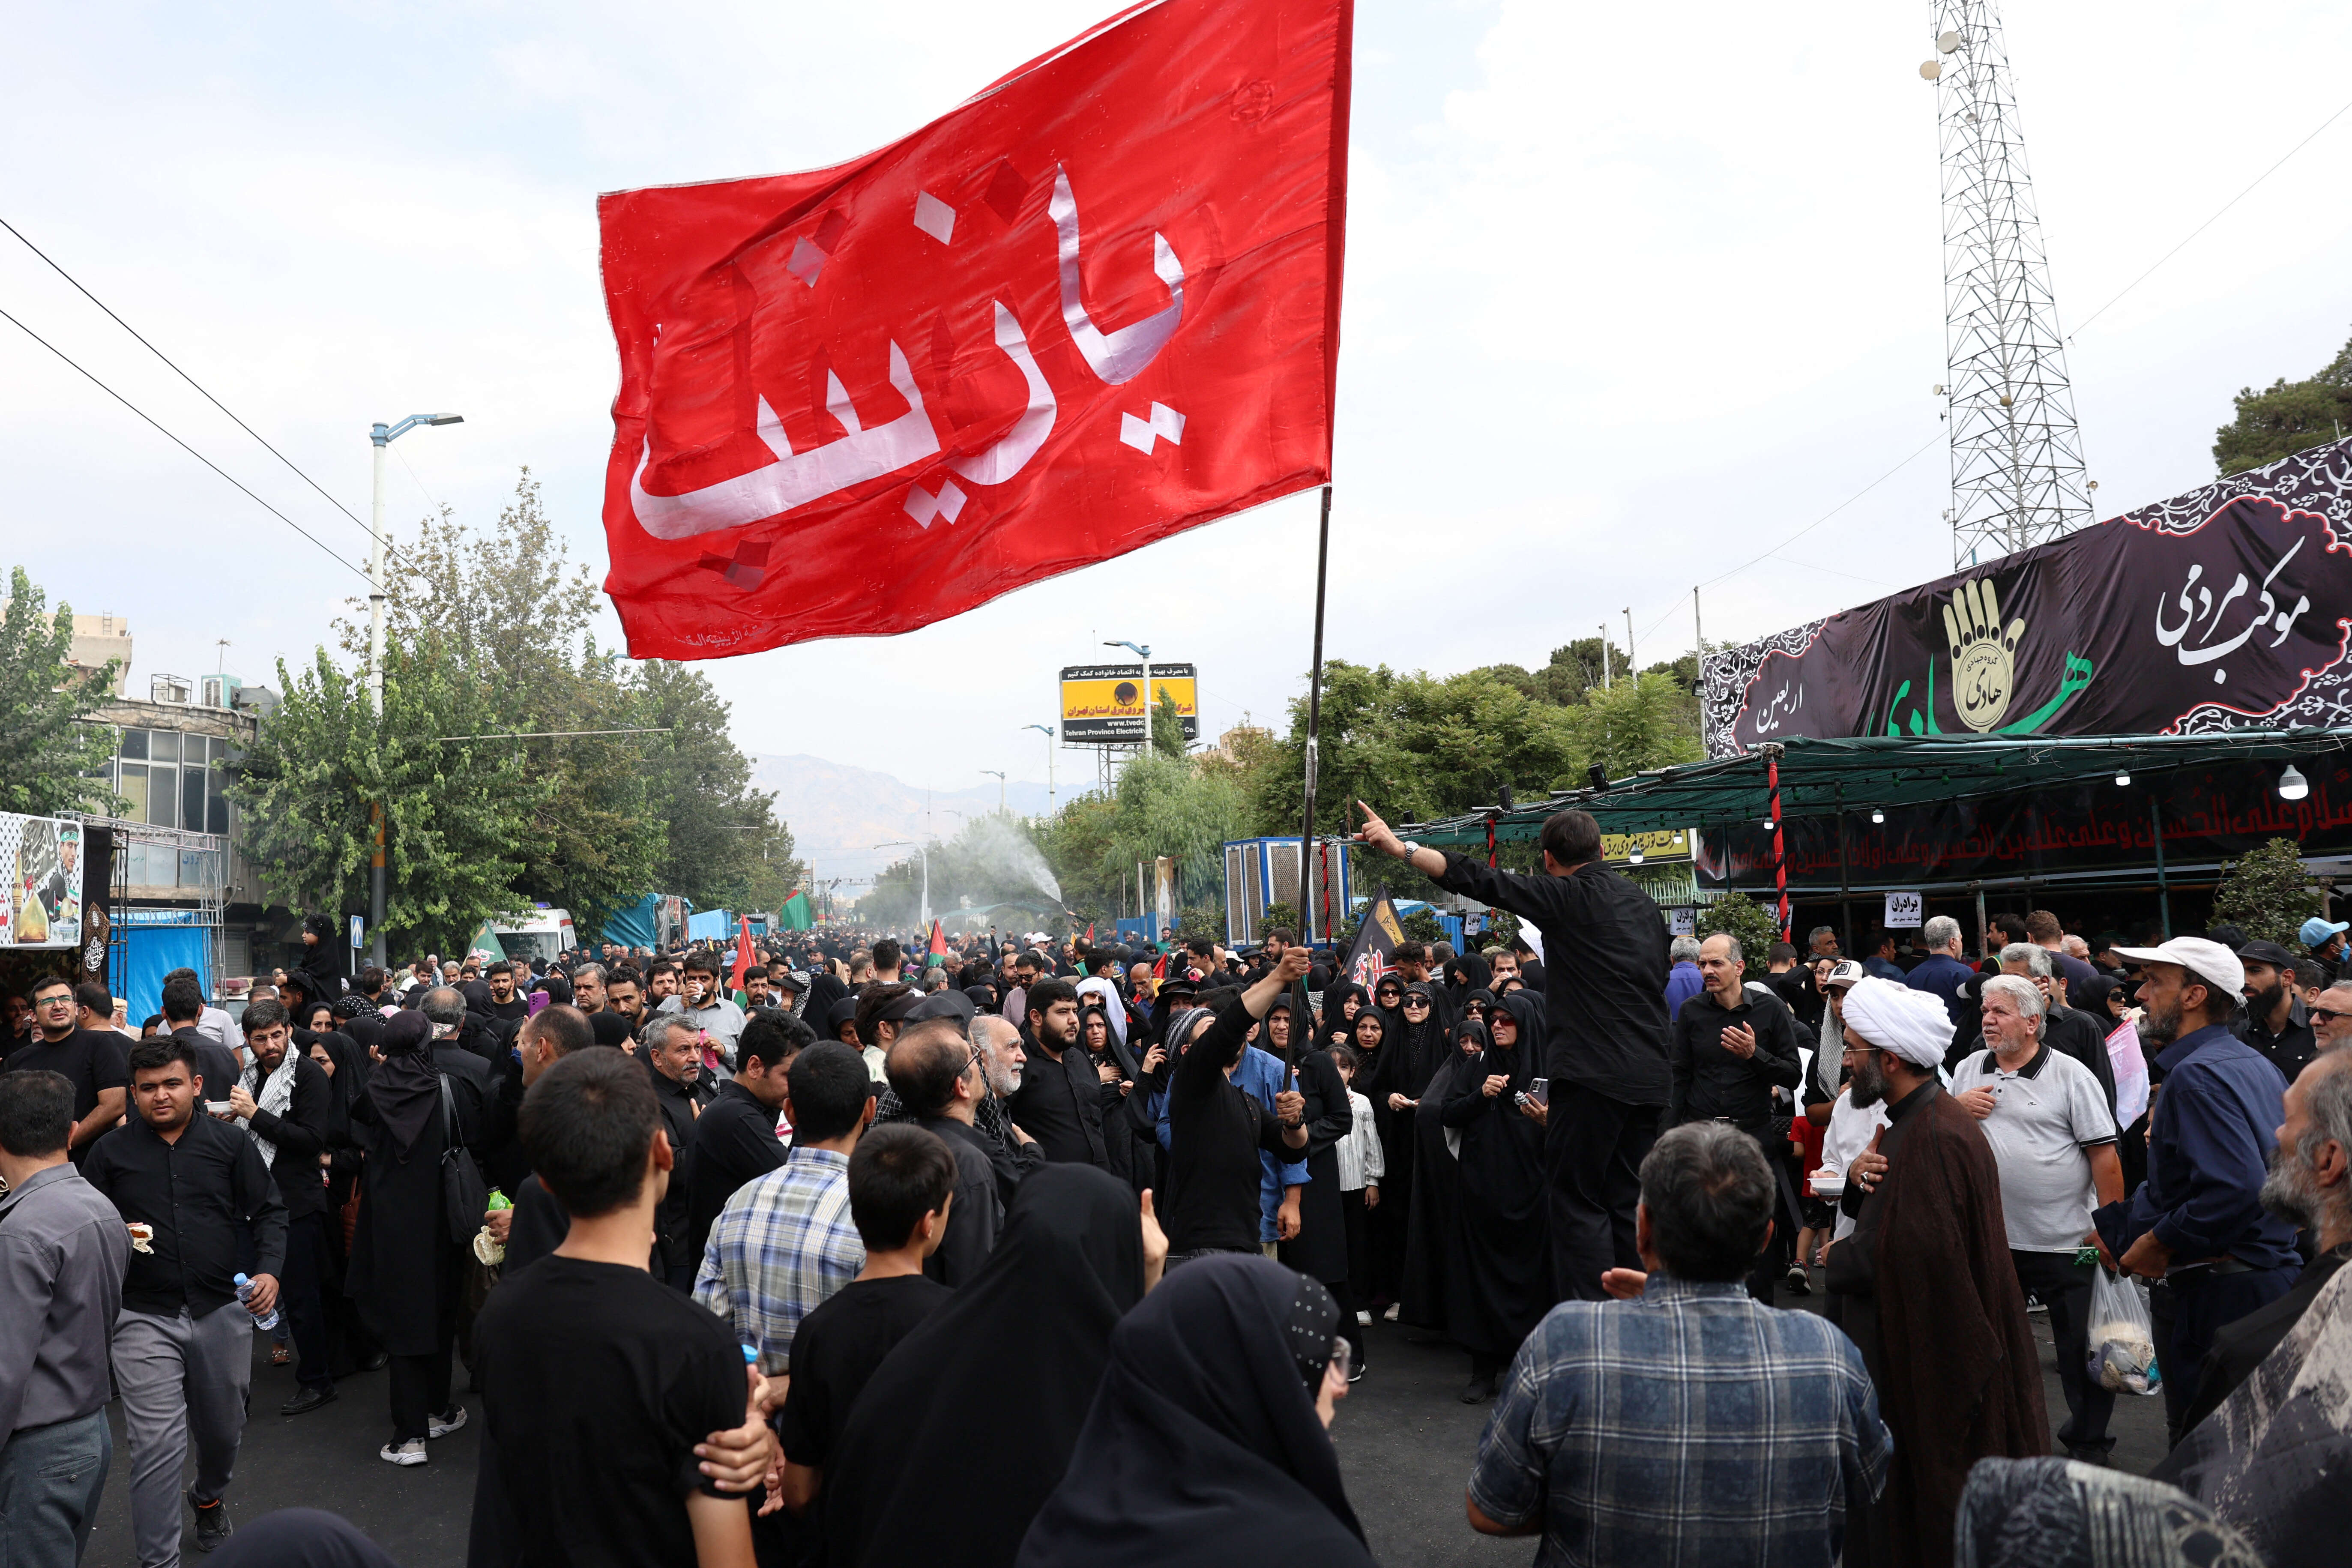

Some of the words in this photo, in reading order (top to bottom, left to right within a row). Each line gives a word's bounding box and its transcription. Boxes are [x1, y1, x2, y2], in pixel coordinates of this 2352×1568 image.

[2156, 564, 2248, 646] مردمی
[2178, 536, 2310, 684] موکب
[1967, 655, 1984, 672] جهادی
[1984, 656, 1999, 665] گروه
[1095, 669, 1116, 677] خانواده
[1966, 667, 2002, 711] هادی
[1068, 706, 1089, 716] تهران
[1089, 705, 1110, 715] استان
[1111, 706, 1124, 715] برق
[1176, 703, 1192, 713] شرک
[1757, 679, 1802, 733] اربعین
[1604, 838, 1618, 856] برق
[1892, 896, 1918, 913] برادران
[1676, 910, 1693, 923] برادران
